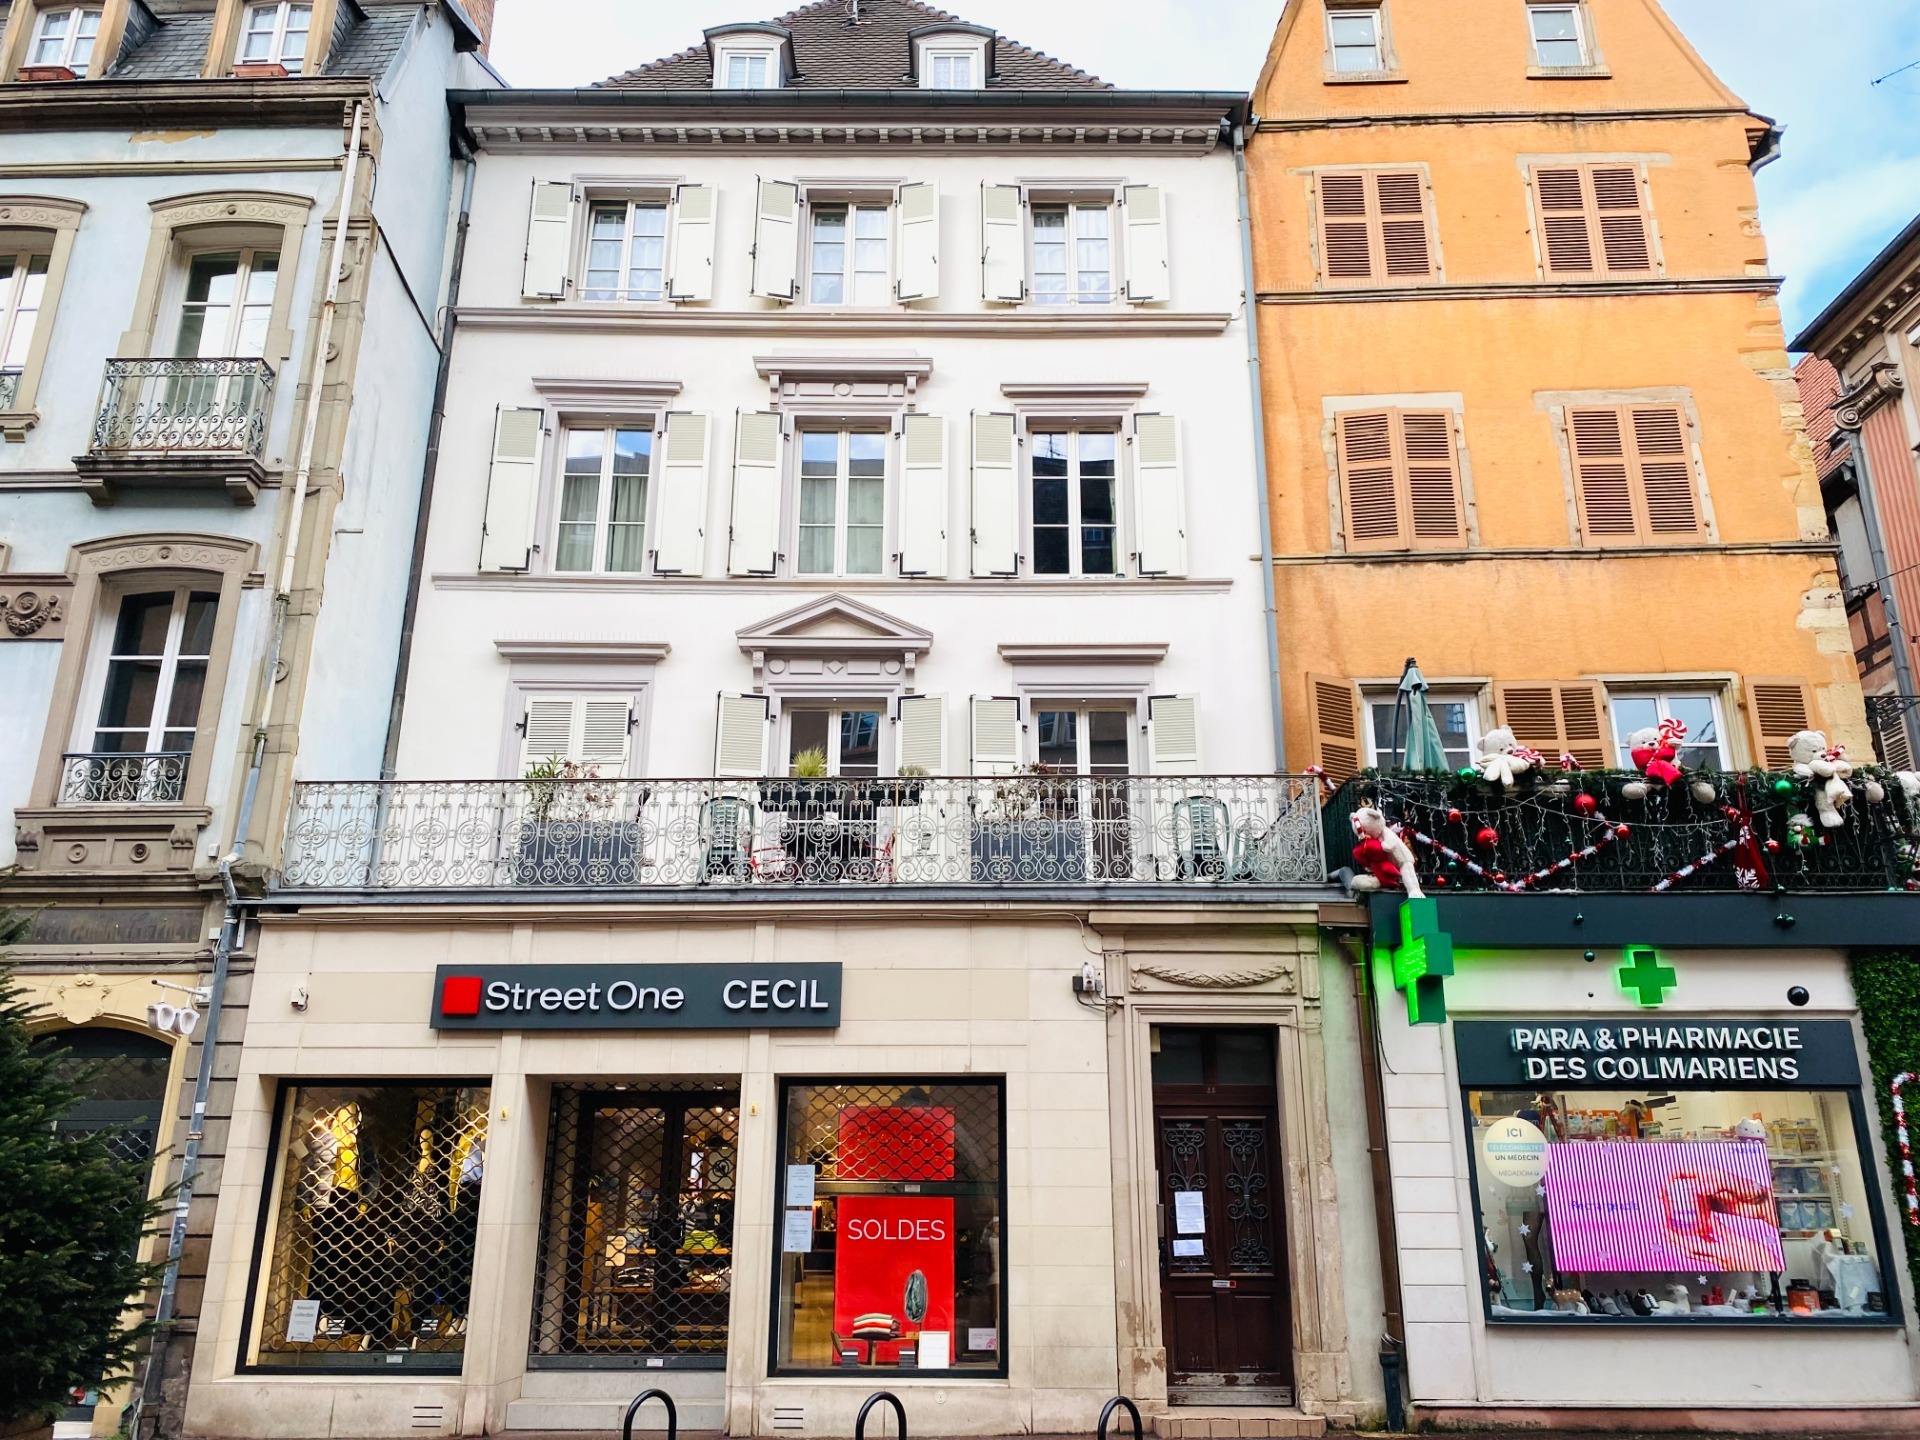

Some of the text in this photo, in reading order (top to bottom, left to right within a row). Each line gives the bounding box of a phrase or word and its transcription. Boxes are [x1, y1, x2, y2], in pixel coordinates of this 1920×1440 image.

[484, 979, 685, 1011] Street One
[722, 978, 830, 1009] CECIL
[1513, 1026, 1803, 1051] PARA & PHARMACIE
[1525, 1056, 1799, 1081] DES COLMARIENS
[1506, 1128, 1522, 1137] ICI
[847, 1218, 946, 1241] SOLDES
